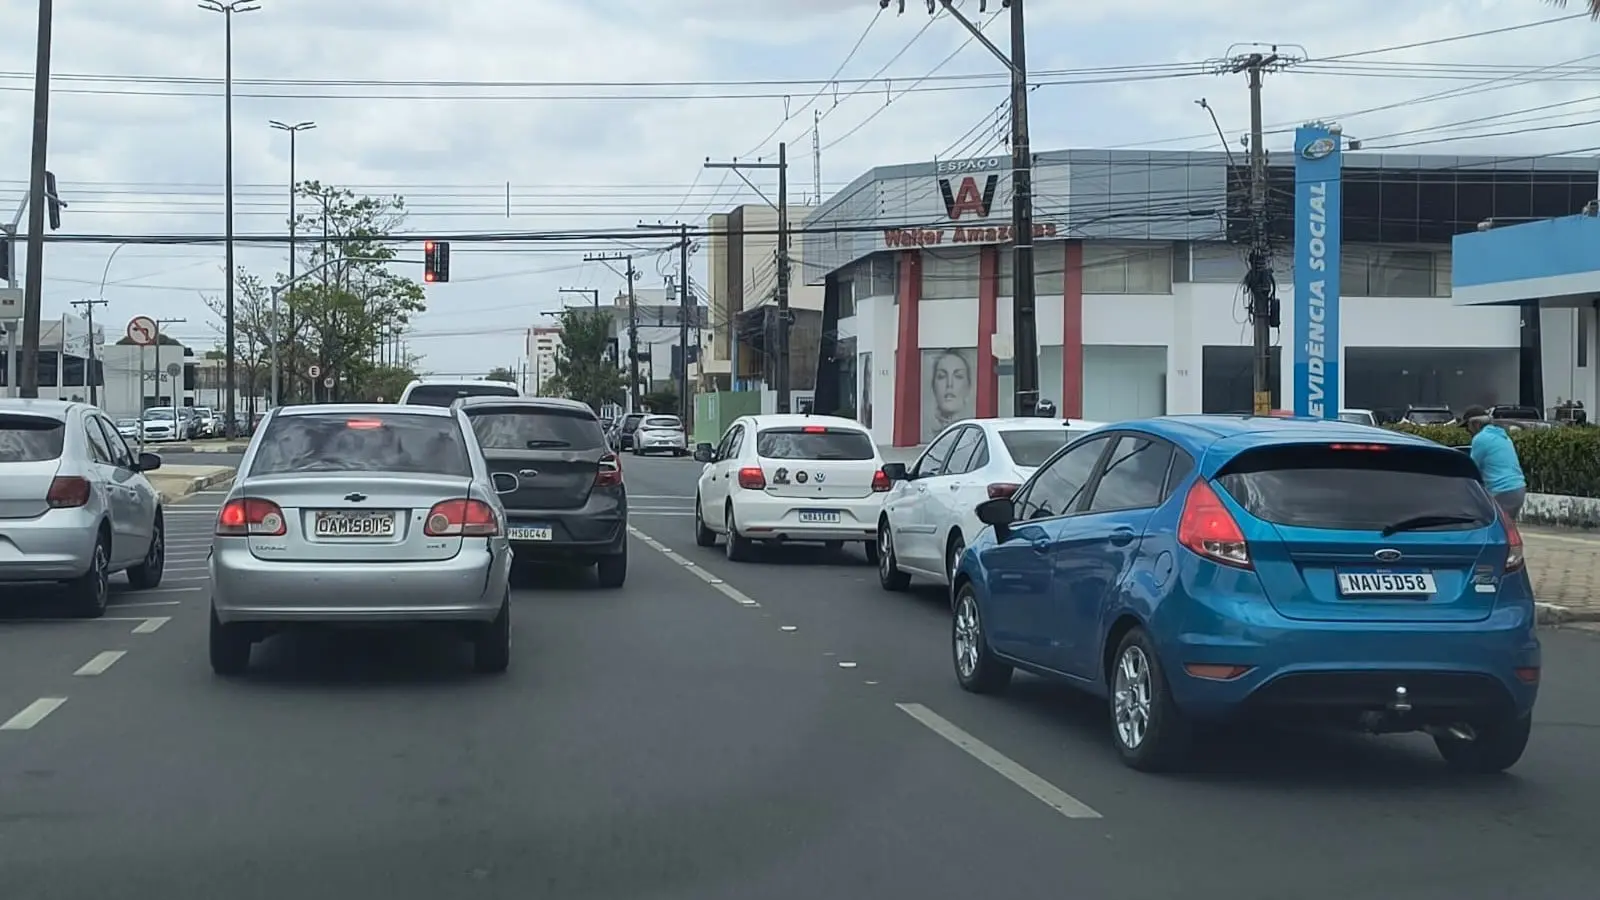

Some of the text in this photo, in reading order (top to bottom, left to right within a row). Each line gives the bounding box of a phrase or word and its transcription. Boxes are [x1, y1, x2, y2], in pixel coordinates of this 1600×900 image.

[938, 158, 998, 173] ESPAÇO
[884, 223, 1056, 248] Walter Amazas
[1309, 182, 1326, 271] SOCIAL
[1348, 575, 1426, 590] NAV5D58
